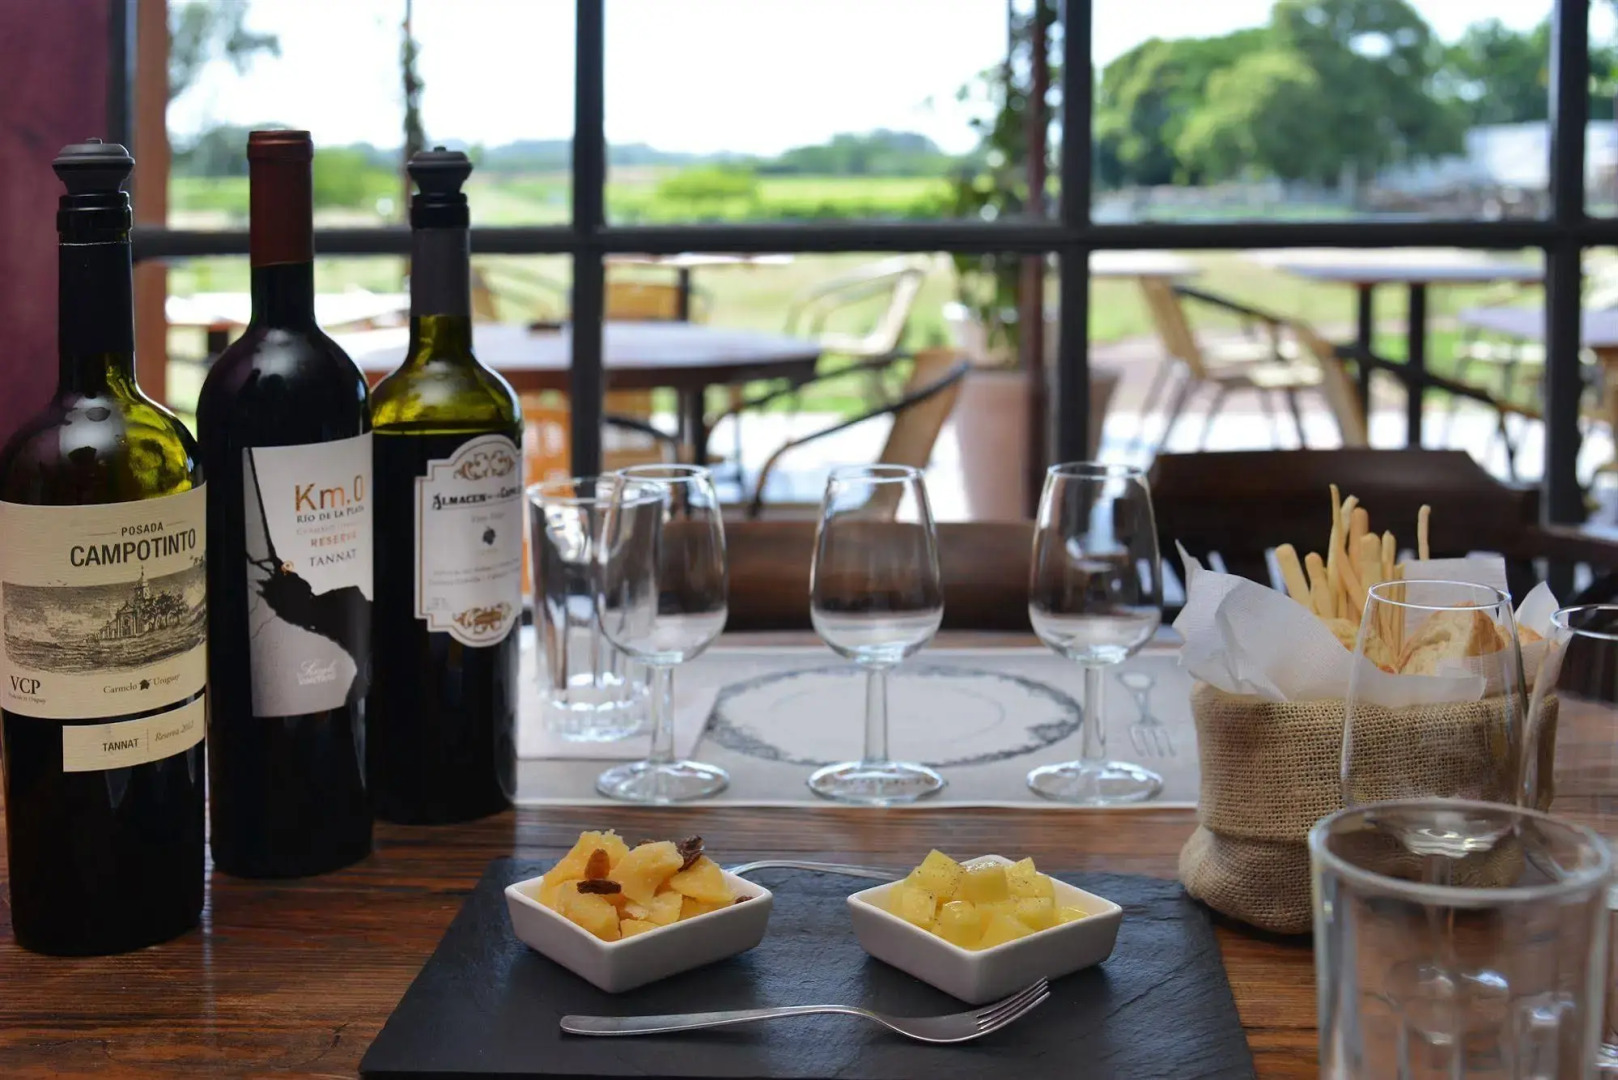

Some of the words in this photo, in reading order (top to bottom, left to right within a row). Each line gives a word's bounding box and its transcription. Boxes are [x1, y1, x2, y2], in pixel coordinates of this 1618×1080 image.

[294, 474, 364, 512] Km.0
[319, 512, 332, 521] DE
[334, 509, 345, 518] LA
[121, 521, 164, 537] POSADA
[70, 527, 196, 567] CAMPOTINTO
[309, 548, 357, 567] TANNAT
[10, 675, 41, 695] VCP
[103, 682, 138, 694] Carmelo
[102, 738, 140, 752] TANNAT
[155, 729, 180, 742] Reserva
